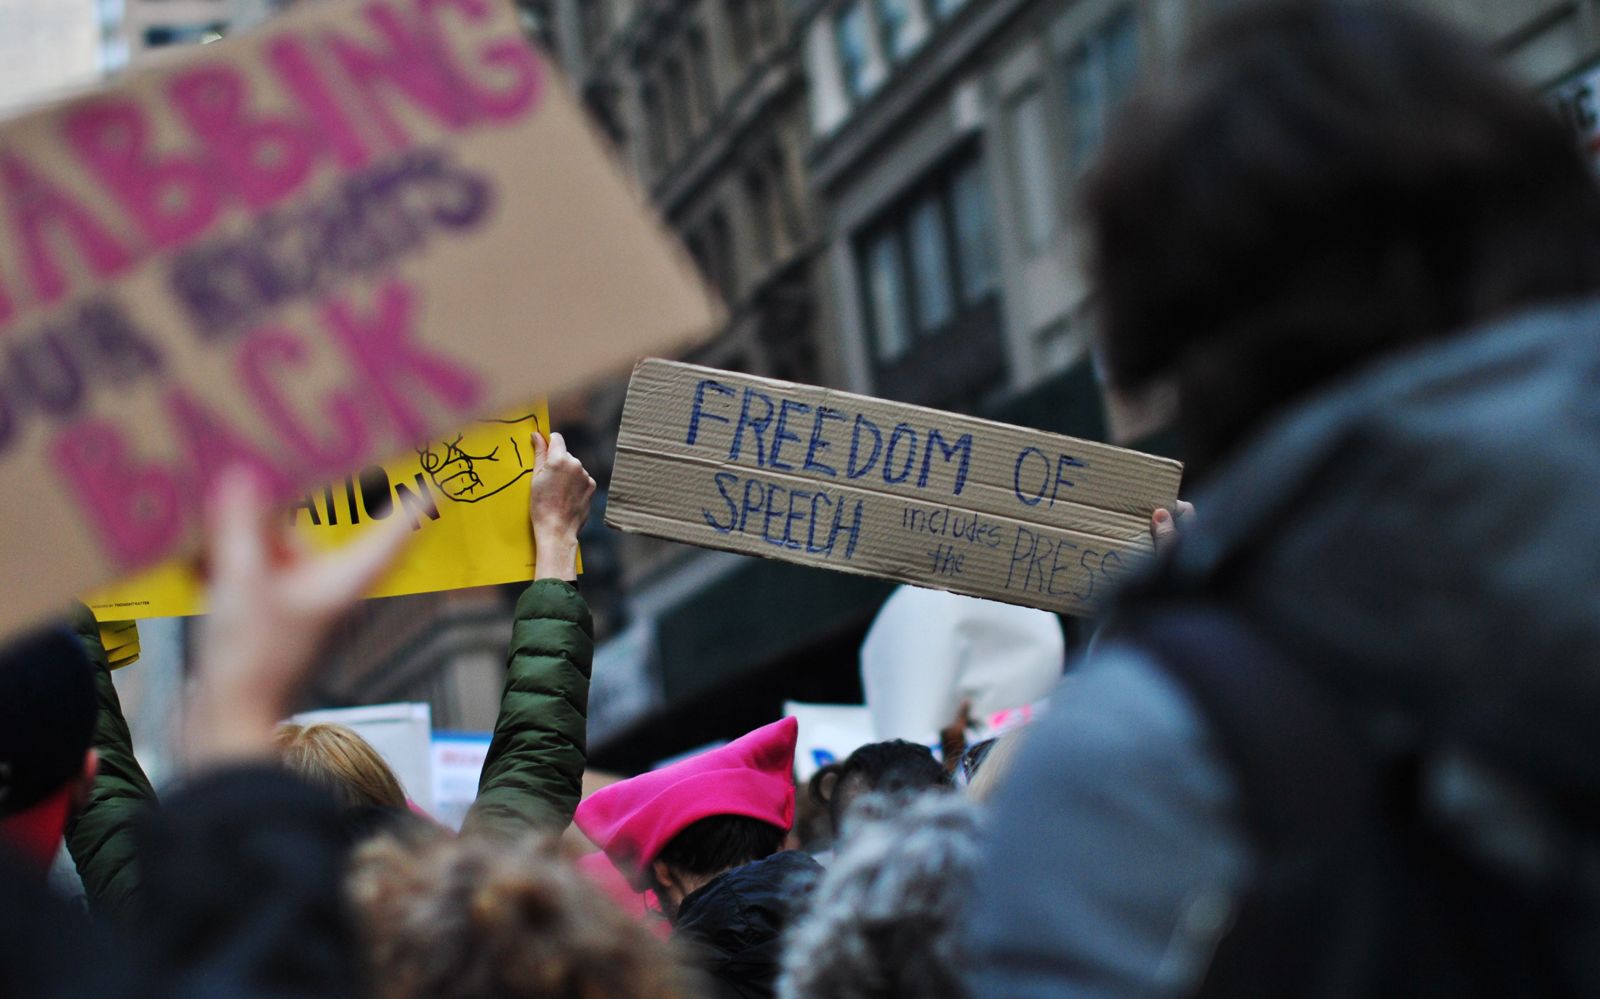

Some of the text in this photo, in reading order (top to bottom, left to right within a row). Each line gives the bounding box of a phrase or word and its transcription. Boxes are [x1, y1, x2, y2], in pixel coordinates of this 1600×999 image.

[0, 0, 543, 325] ABBING
[46, 280, 484, 574] BACK
[685, 379, 1089, 508] FREEDOM OF
[701, 472, 864, 560] SPEECH
[902, 502, 1003, 549] includes
[927, 543, 967, 576] the
